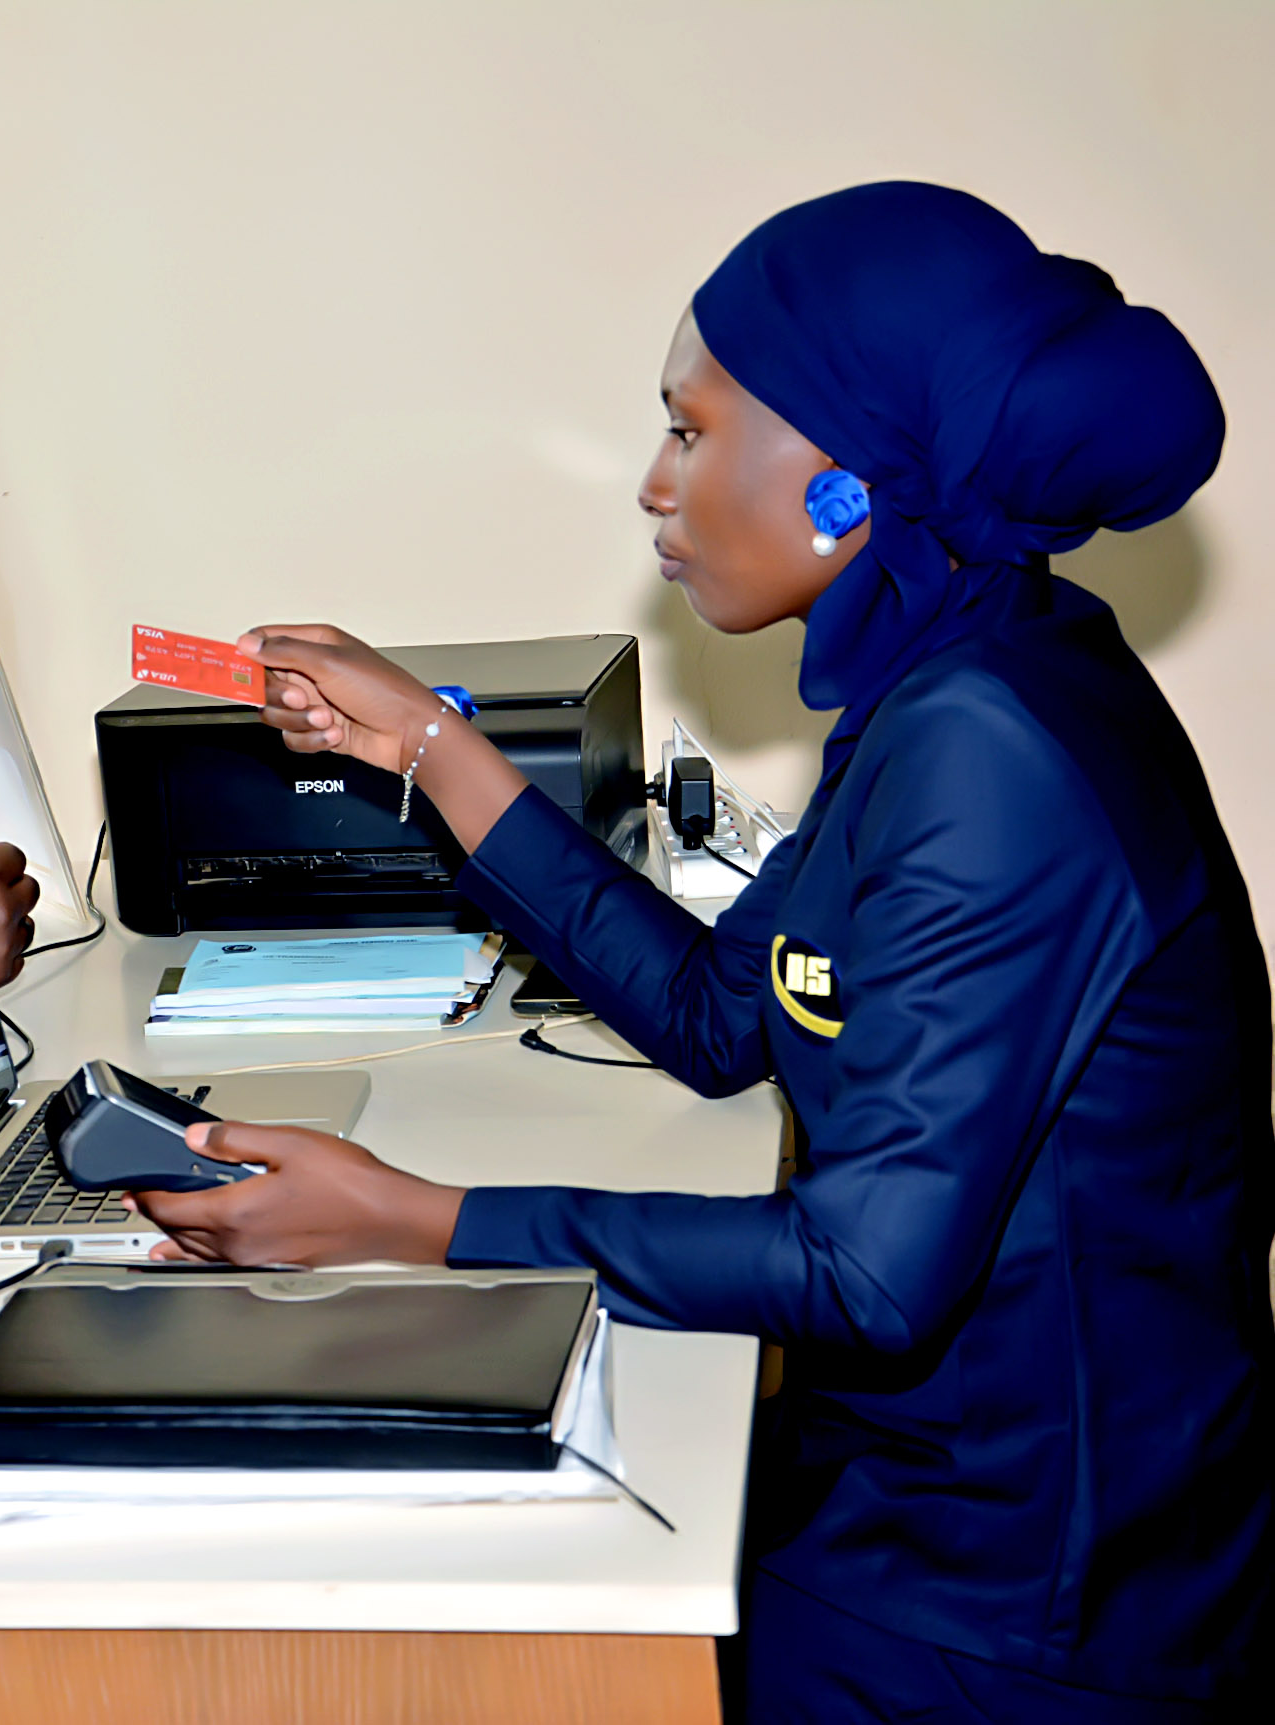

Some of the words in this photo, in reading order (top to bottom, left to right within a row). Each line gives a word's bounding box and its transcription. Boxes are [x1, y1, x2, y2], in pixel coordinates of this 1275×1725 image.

[136, 626, 165, 640] VISA
[150, 670, 177, 683] UBA
[295, 780, 344, 794] EPSON
